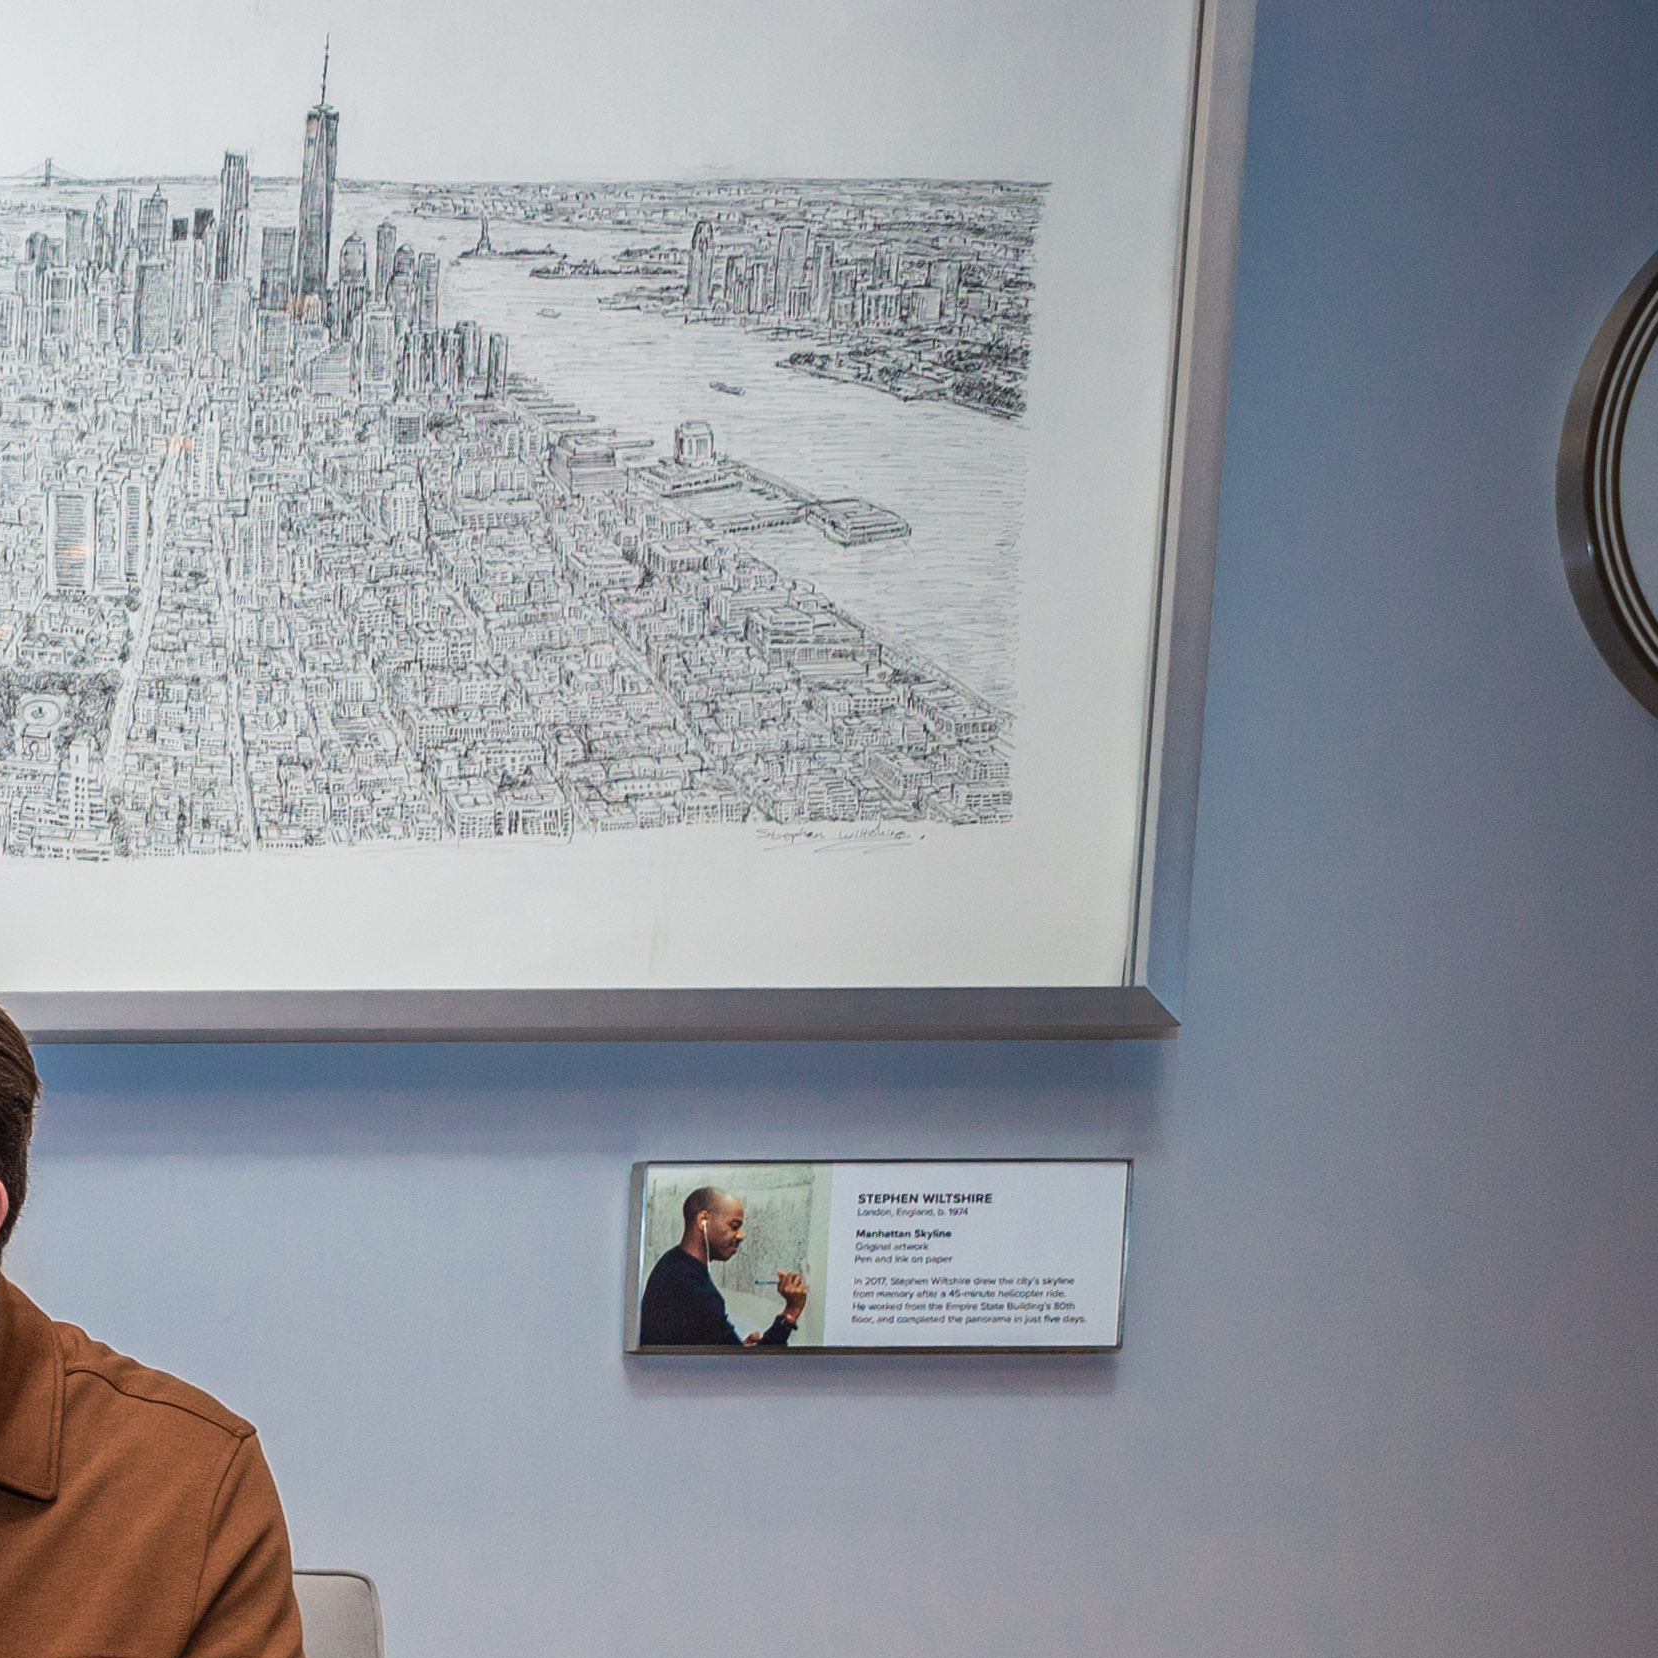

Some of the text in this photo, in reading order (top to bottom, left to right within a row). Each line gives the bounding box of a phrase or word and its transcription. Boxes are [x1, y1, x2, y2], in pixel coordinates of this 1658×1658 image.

[857, 1193, 993, 1204] STEPHEN WILTSHIRE
[857, 1207, 969, 1218] London, England, b. 1974
[855, 1229, 952, 1240] Manhattan Skyline
[855, 1242, 930, 1252] Original artwork
[854, 1256, 873, 1264] Pen
[875, 1255, 892, 1264] and
[894, 1255, 909, 1263] ink
[925, 1256, 953, 1266] paper
[852, 1276, 1075, 1287] In 2017, Stephen Wiltshire drew the city's skyline
[852, 1290, 874, 1298] from
[876, 1291, 914, 1300] memory
[916, 1290, 938, 1298] after
[948, 1289, 996, 1298] 45-minute
[997, 1289, 1044, 1299] helicopter
[1046, 1289, 1067, 1298] ride.
[852, 1302, 1075, 1312] He worked from the Empire State Building's 80th
[851, 1314, 1087, 1325] floor, and completed the panorama in just five days.
